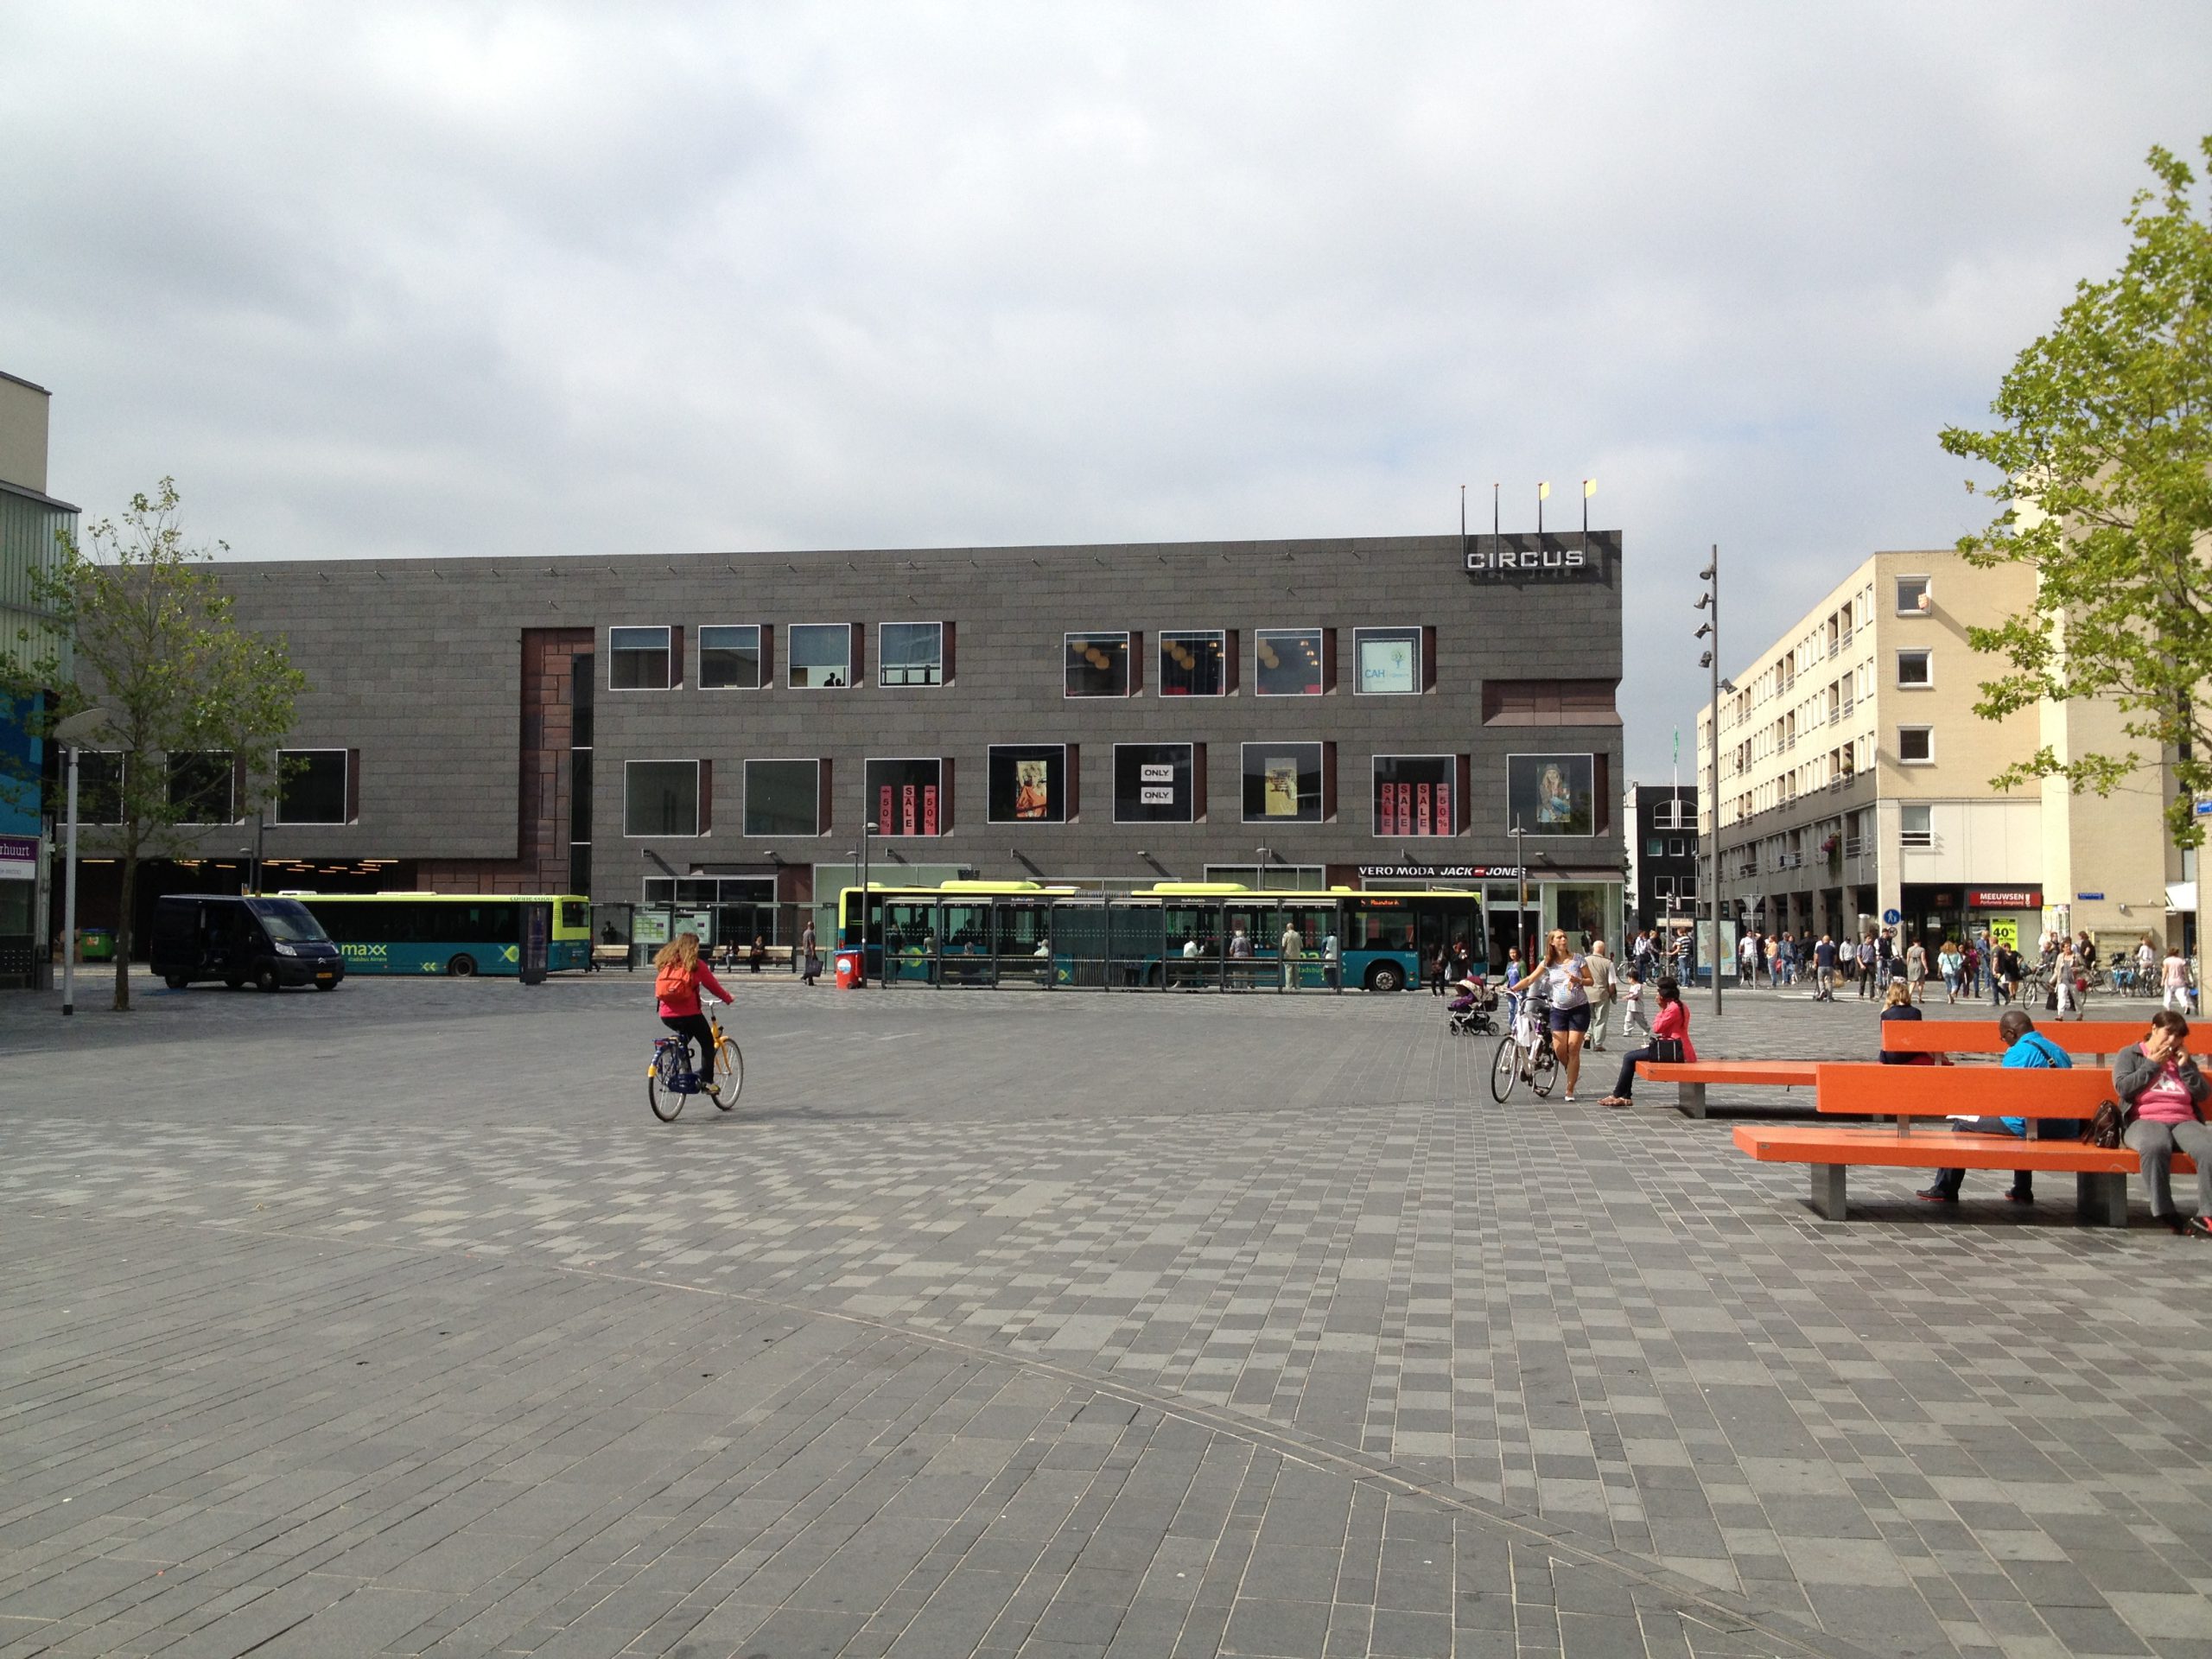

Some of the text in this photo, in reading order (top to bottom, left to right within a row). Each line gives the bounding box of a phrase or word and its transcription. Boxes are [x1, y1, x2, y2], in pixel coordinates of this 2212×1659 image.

[1467, 550, 1584, 569] CIRCUS
[1364, 669, 1385, 678] CAH
[905, 787, 913, 828] SALE
[1400, 785, 1408, 827] SALE
[1419, 785, 1427, 827] SALE
[1358, 867, 1435, 876] VERO MODA
[1440, 867, 1473, 876] JACK
[1485, 867, 1527, 876] JONES
[341, 944, 388, 956] maxx
